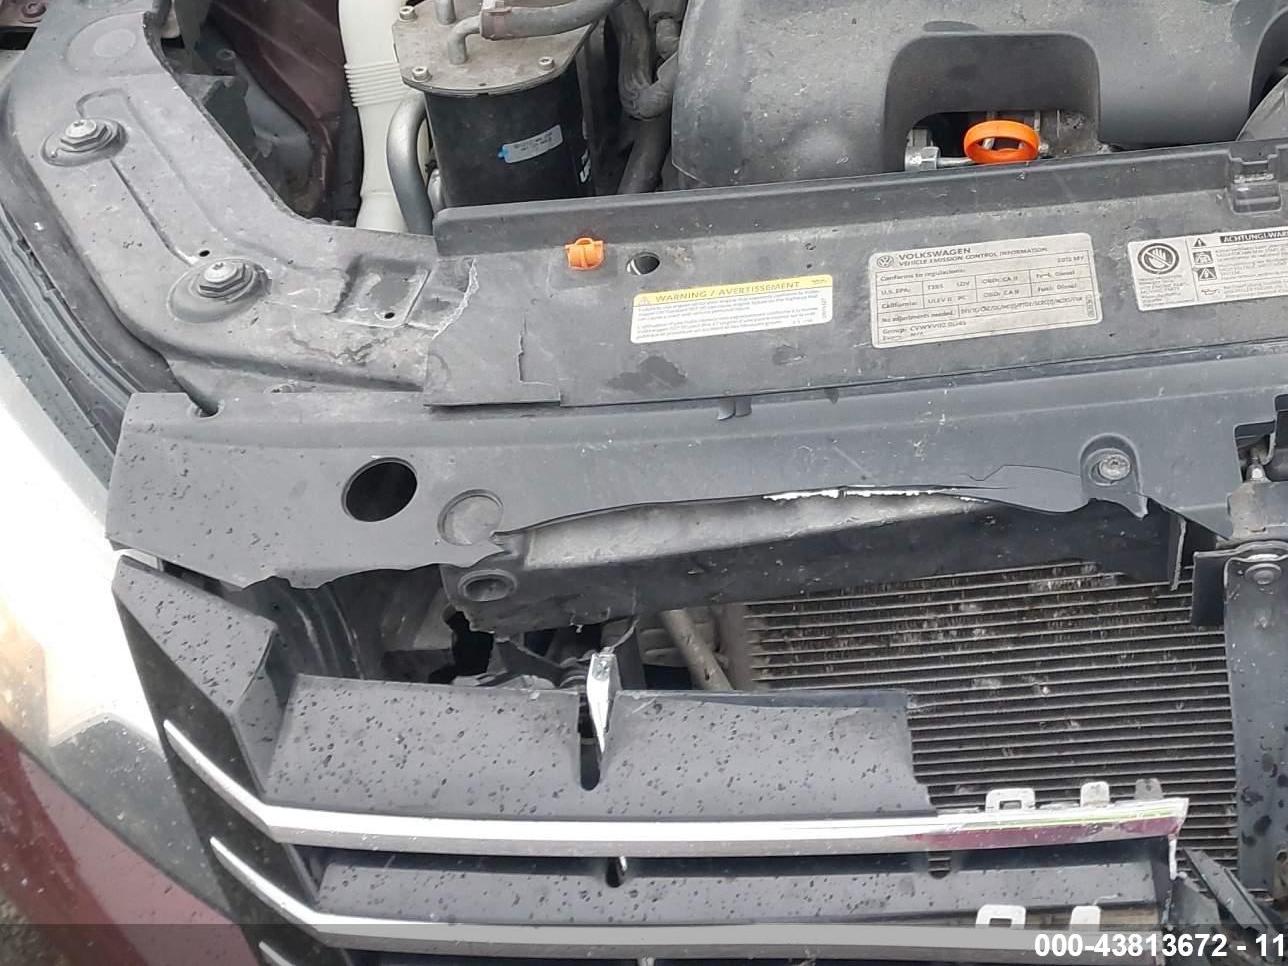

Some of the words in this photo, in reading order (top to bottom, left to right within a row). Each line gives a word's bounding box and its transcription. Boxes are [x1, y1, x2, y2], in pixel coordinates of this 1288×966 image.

[899, 247, 971, 260] VOLKSWAGEN
[929, 254, 964, 264] EMISSION
[965, 251, 998, 260] CONTROL
[655, 290, 707, 303] WARNING
[718, 281, 800, 296] AVERTISSEMENT
